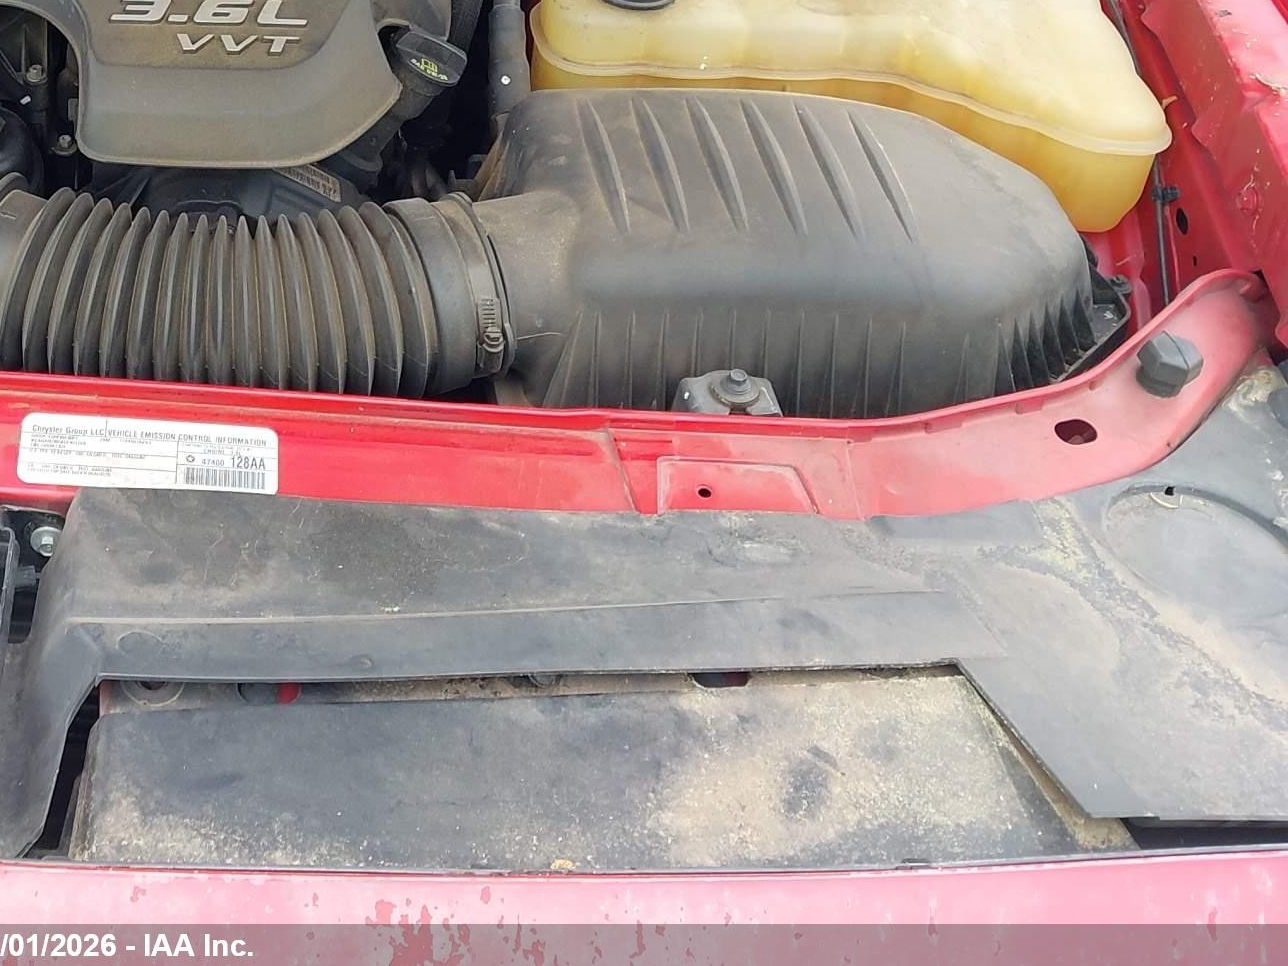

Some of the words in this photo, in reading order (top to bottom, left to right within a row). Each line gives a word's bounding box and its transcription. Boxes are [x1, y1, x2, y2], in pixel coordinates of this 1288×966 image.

[176, 33, 301, 55] VVT
[32, 424, 63, 434] Chrysler
[65, 426, 89, 436] Group
[90, 427, 106, 437] LLC
[108, 429, 138, 439] VEHICLE
[140, 431, 176, 441] EMISSION
[178, 434, 212, 443] CONTROL
[215, 436, 267, 447] INFORMATION
[231, 456, 266, 470] 128AA
